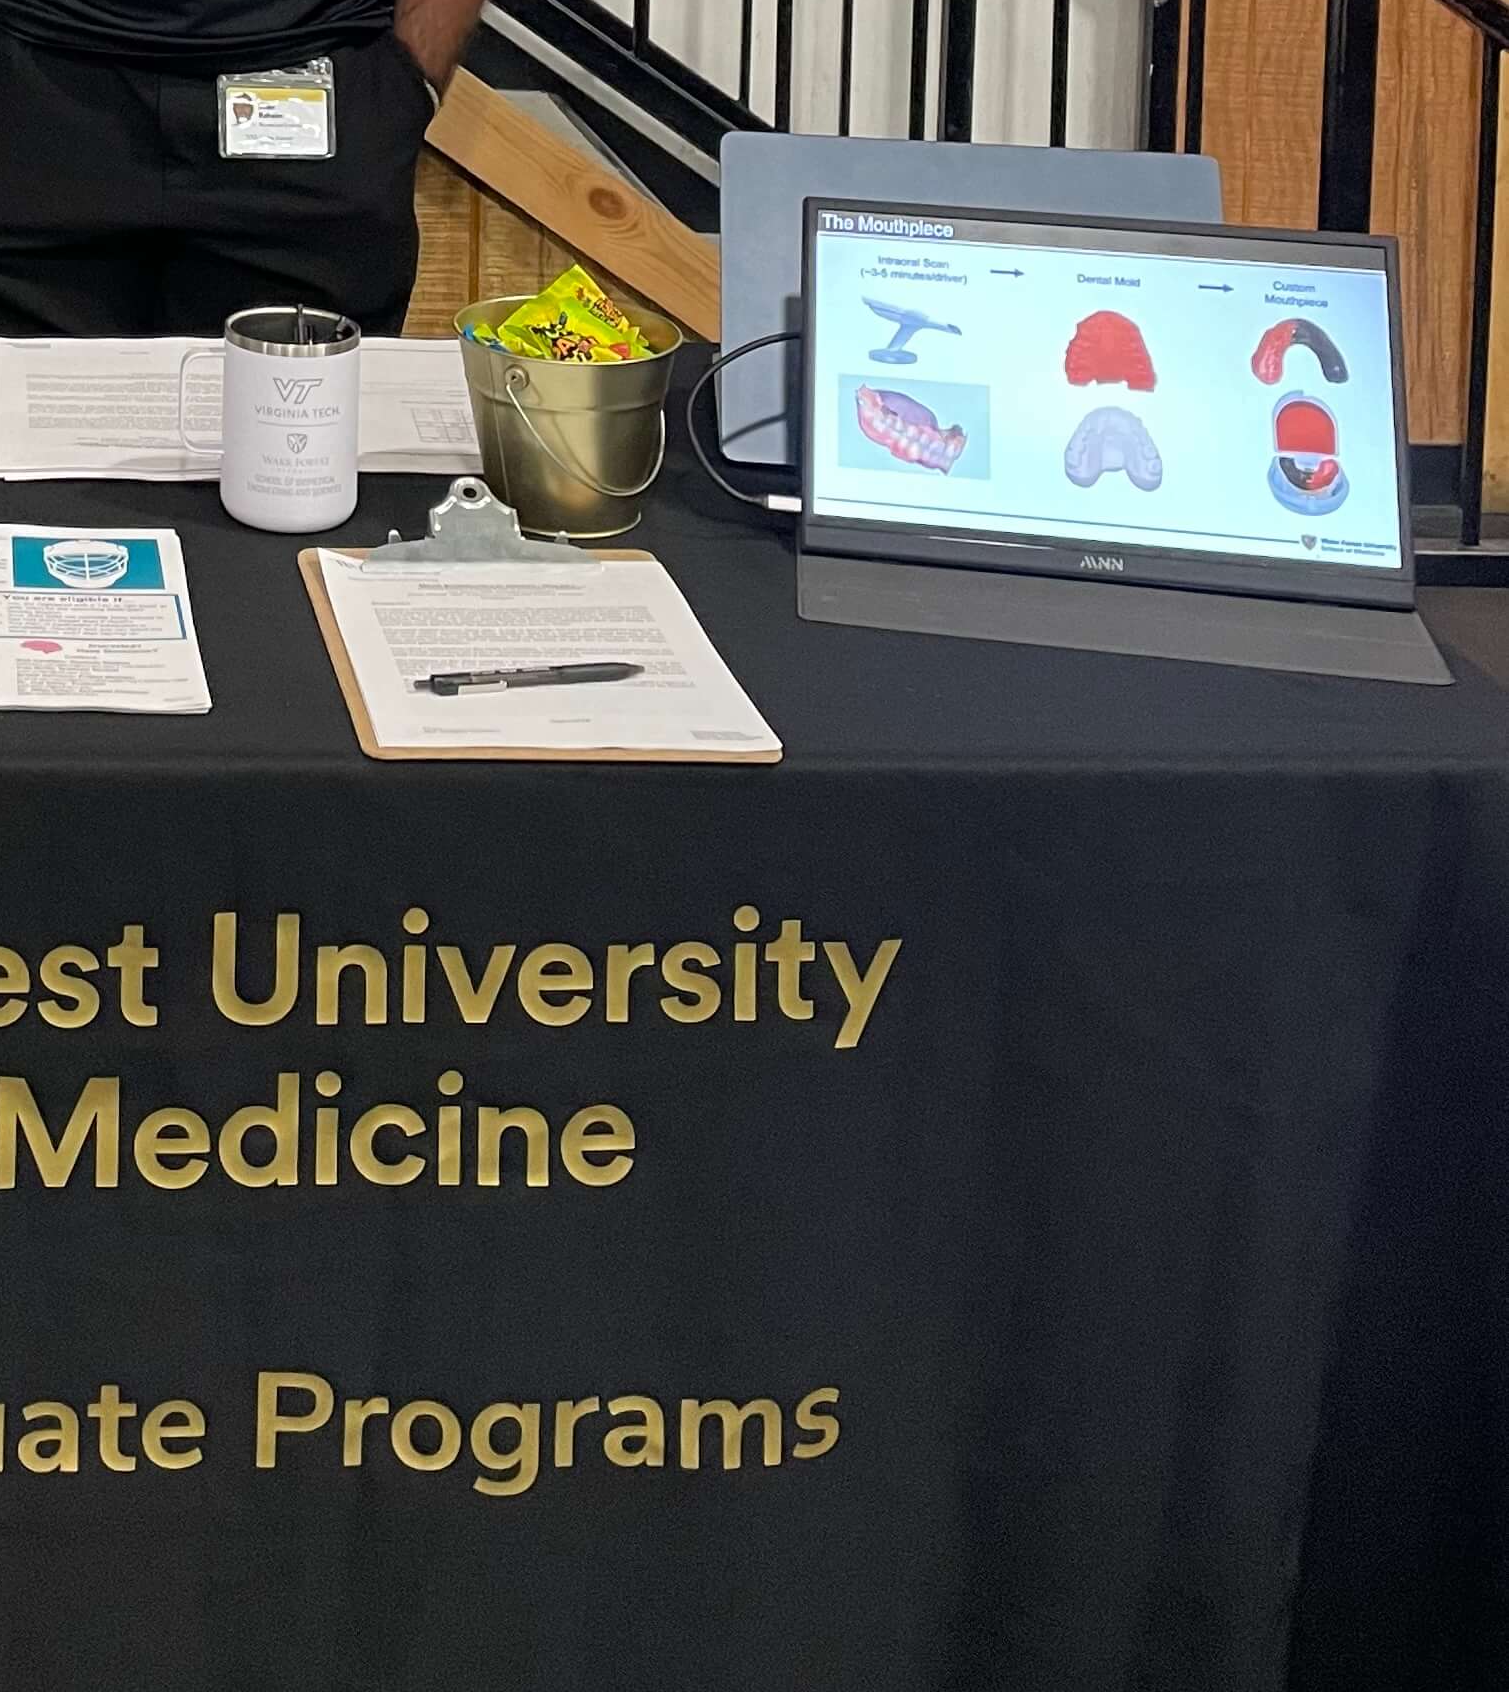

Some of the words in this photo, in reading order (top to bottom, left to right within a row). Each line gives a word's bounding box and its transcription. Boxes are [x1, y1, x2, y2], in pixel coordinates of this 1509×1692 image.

[822, 213, 854, 230] The
[857, 215, 955, 238] Mouthpiece
[877, 255, 920, 267] Intraoral
[923, 257, 950, 269] Scan
[1076, 273, 1112, 285] Dental
[1114, 276, 1141, 288] Mold
[1272, 280, 1316, 293] Custom
[1264, 293, 1329, 309] Mouthpiece
[272, 377, 324, 404] VT
[253, 404, 310, 419] VIRGINIA
[311, 405, 340, 419] TECH
[212, 906, 901, 1049] University
[255, 1371, 840, 1497] Programs
